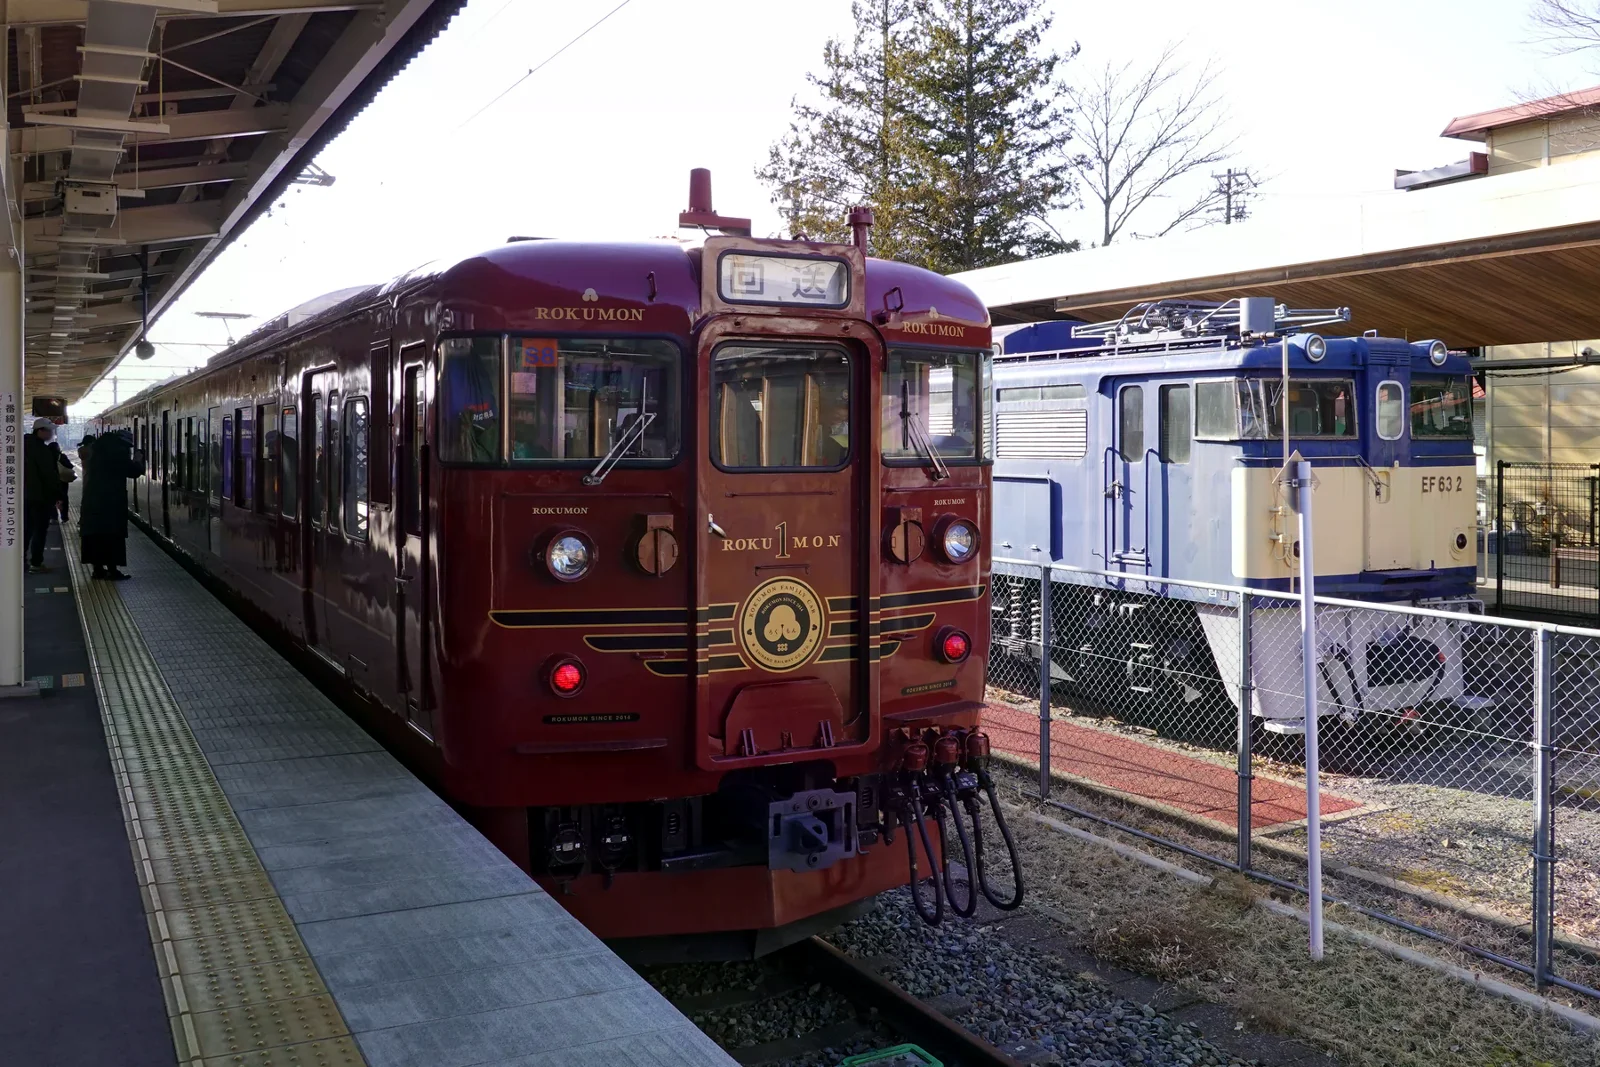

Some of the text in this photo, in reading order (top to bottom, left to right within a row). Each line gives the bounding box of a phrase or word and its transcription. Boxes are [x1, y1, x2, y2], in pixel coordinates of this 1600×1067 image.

[729, 262, 827, 300] 回送
[534, 306, 646, 321] ROKUMON
[902, 321, 966, 338] ROKUMON
[524, 346, 556, 365] S8
[5, 394, 16, 547] 1番線の列車最後尾はこちらです
[934, 498, 966, 506] ROKUMON
[532, 507, 589, 515] ROKUMON
[721, 537, 773, 551] ROKU
[793, 535, 841, 549] MON
[749, 584, 816, 618] ROKUMON FAMILY CAR
[761, 598, 782, 615] ROKUMON
[551, 715, 588, 723] ROKUMON
[590, 714, 613, 722] SINCE
